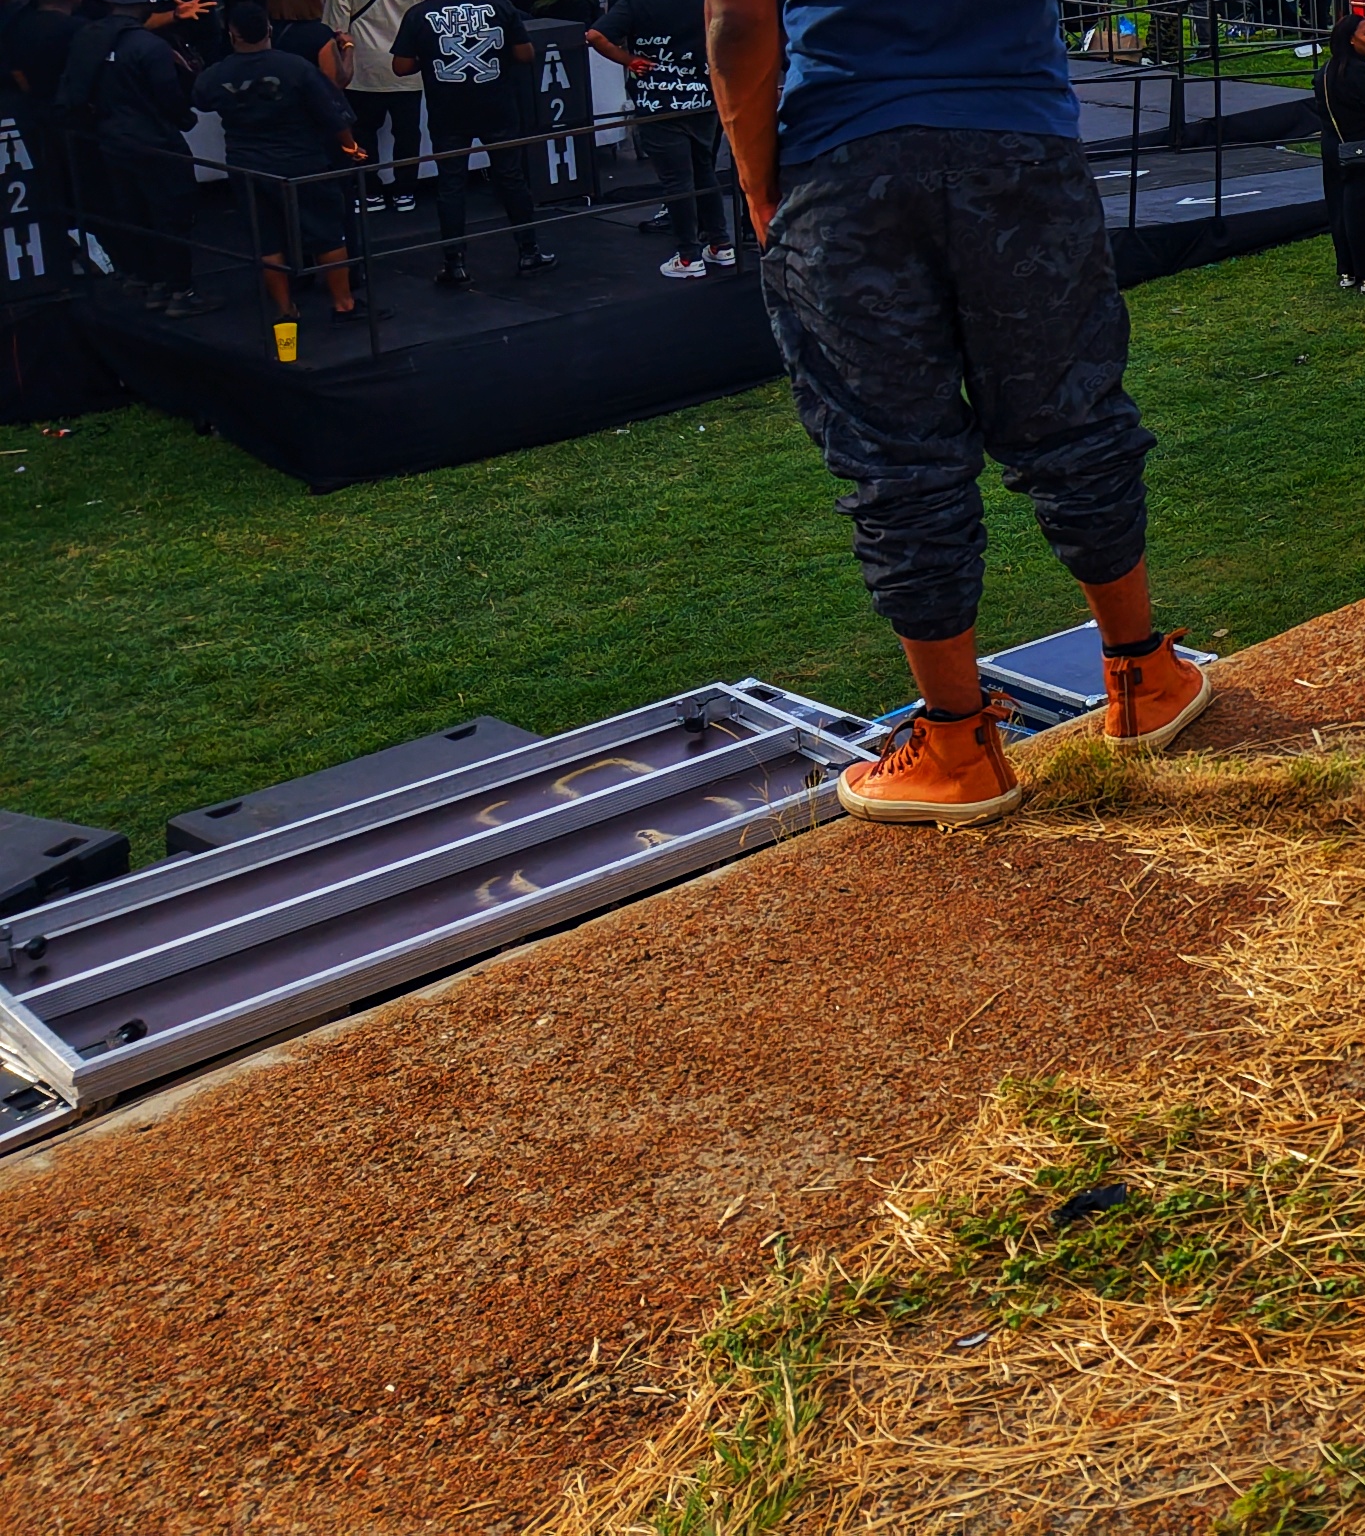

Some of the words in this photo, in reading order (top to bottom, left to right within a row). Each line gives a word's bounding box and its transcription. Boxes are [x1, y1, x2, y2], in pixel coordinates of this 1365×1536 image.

[636, 35, 671, 45] ever
[637, 76, 708, 91] entertain
[636, 91, 663, 112] the
